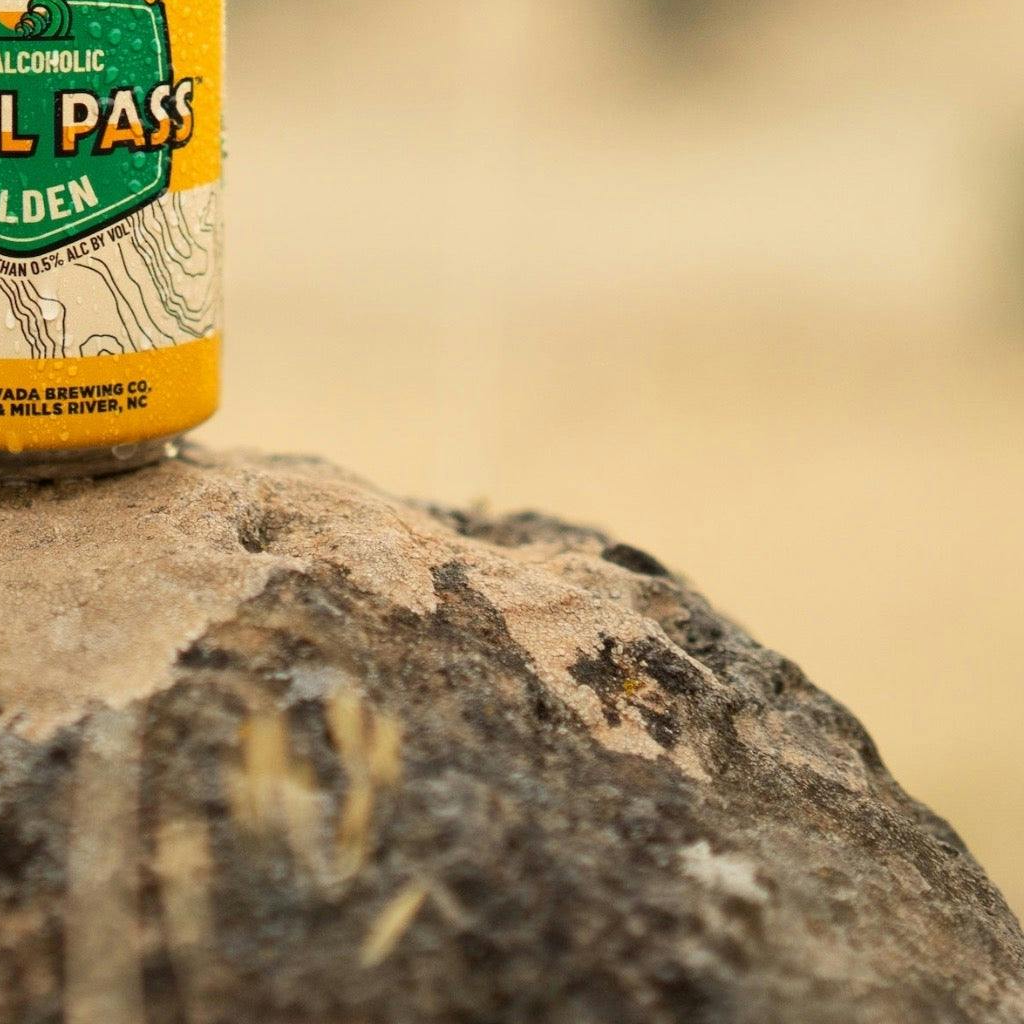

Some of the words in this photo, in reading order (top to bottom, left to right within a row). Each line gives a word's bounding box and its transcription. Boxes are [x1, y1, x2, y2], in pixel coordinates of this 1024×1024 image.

[30, 252, 65, 276] 0.5%
[66, 241, 90, 263] ALC
[90, 233, 105, 252] BY
[45, 383, 124, 400] BREWING
[127, 380, 152, 394] CO.
[10, 402, 63, 417] MILLS
[67, 398, 123, 414] RIVER,
[127, 394, 149, 410] NC
